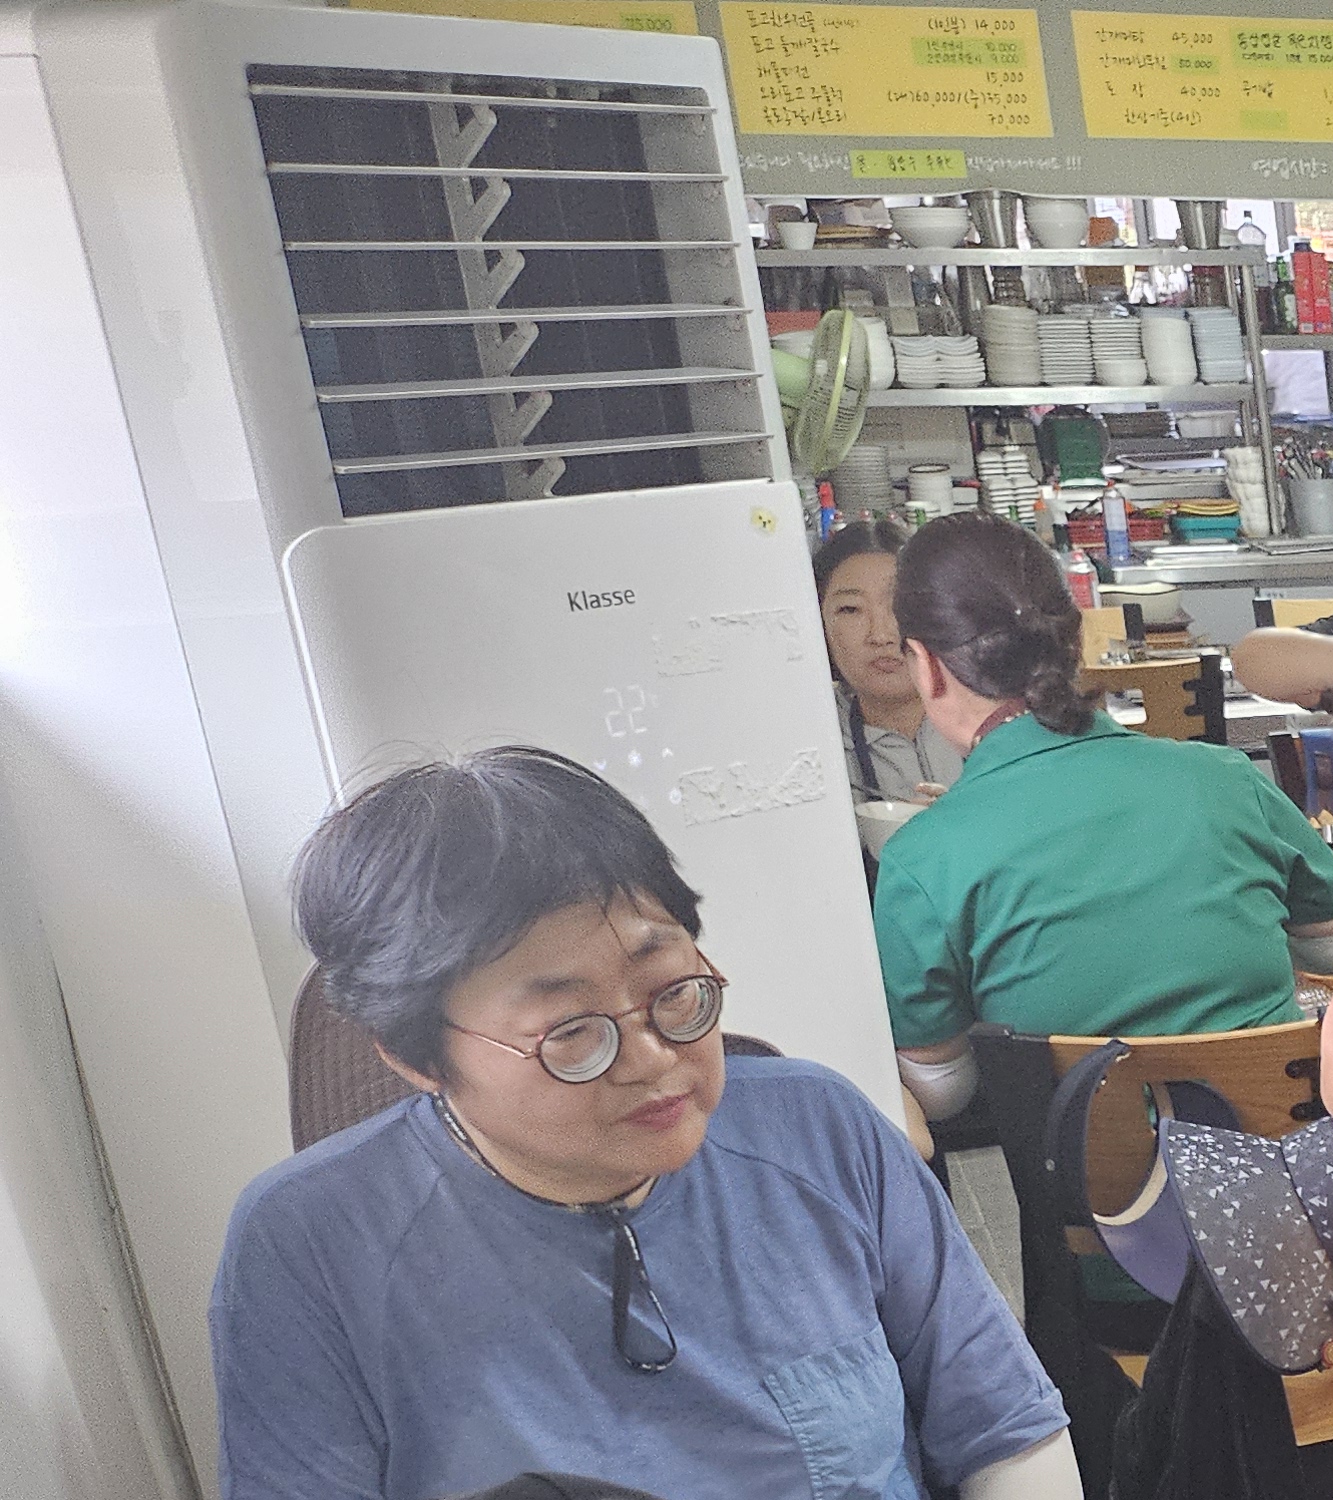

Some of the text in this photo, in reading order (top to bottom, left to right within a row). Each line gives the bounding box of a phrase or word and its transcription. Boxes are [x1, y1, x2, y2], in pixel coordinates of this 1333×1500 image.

[974, 19, 1016, 35] 14,000
[1171, 32, 1213, 48] 45,000
[986, 71, 1024, 87] 15,000
[1181, 86, 1221, 102] 40,000
[567, 588, 636, 612] Klasse
